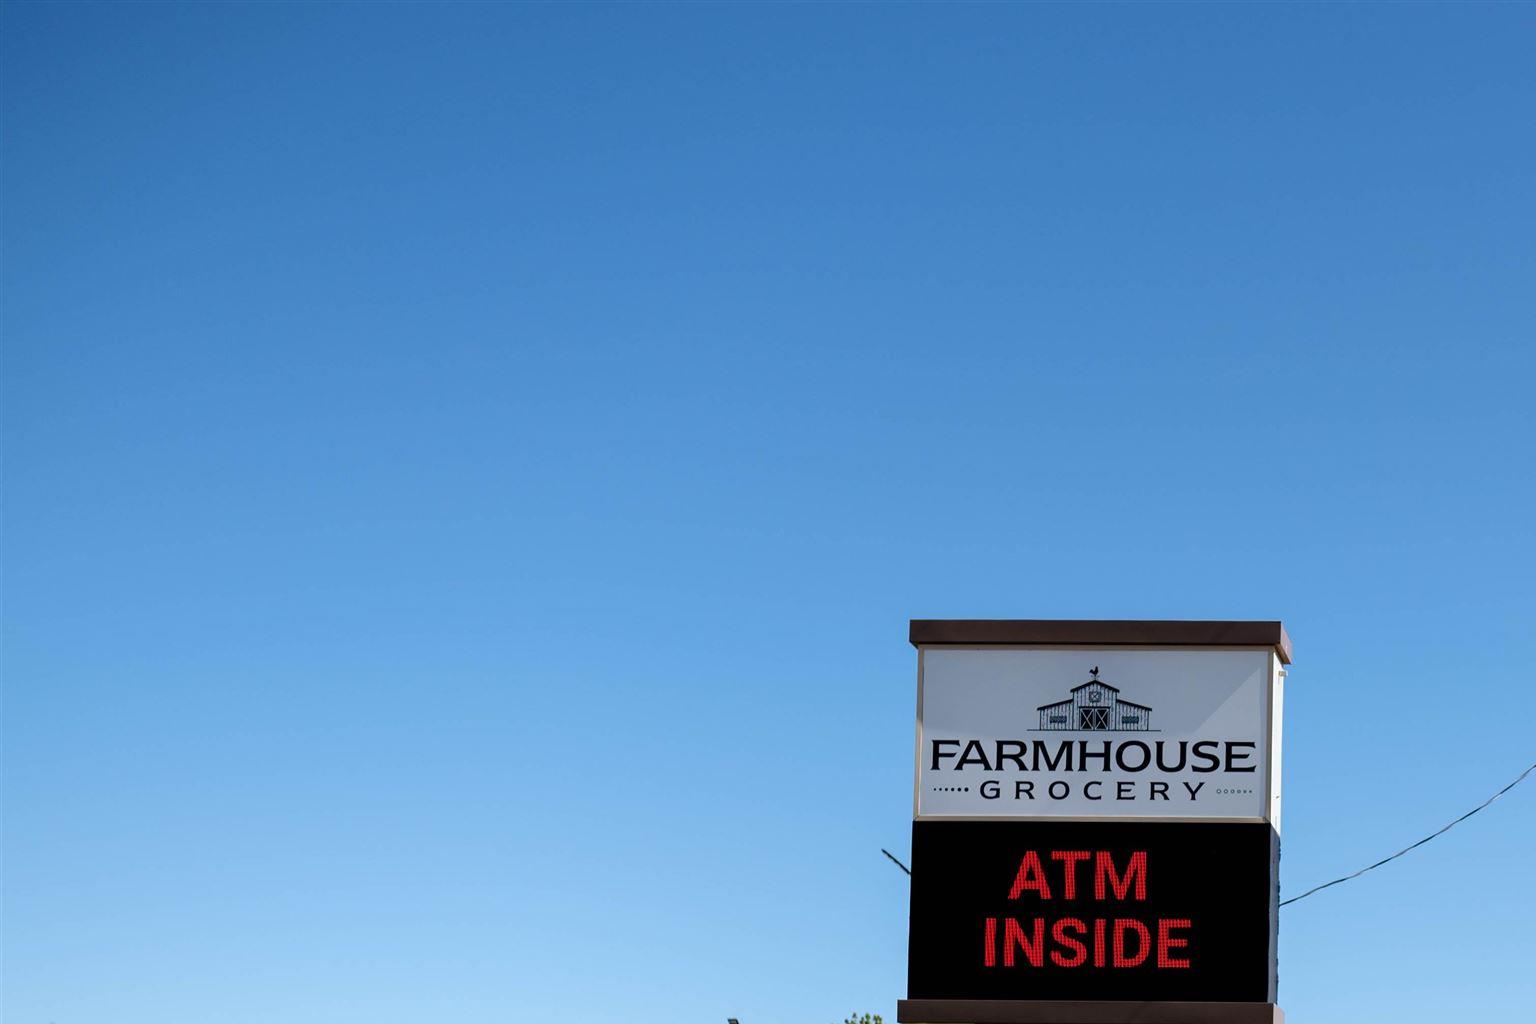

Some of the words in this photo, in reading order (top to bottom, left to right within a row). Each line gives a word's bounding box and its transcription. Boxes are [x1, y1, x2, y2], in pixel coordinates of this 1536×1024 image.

[930, 739, 1257, 773] FARMHOUSE
[979, 780, 1206, 801] GROCERY
[1008, 850, 1147, 900] ATM
[983, 917, 1192, 969] INSIDE
